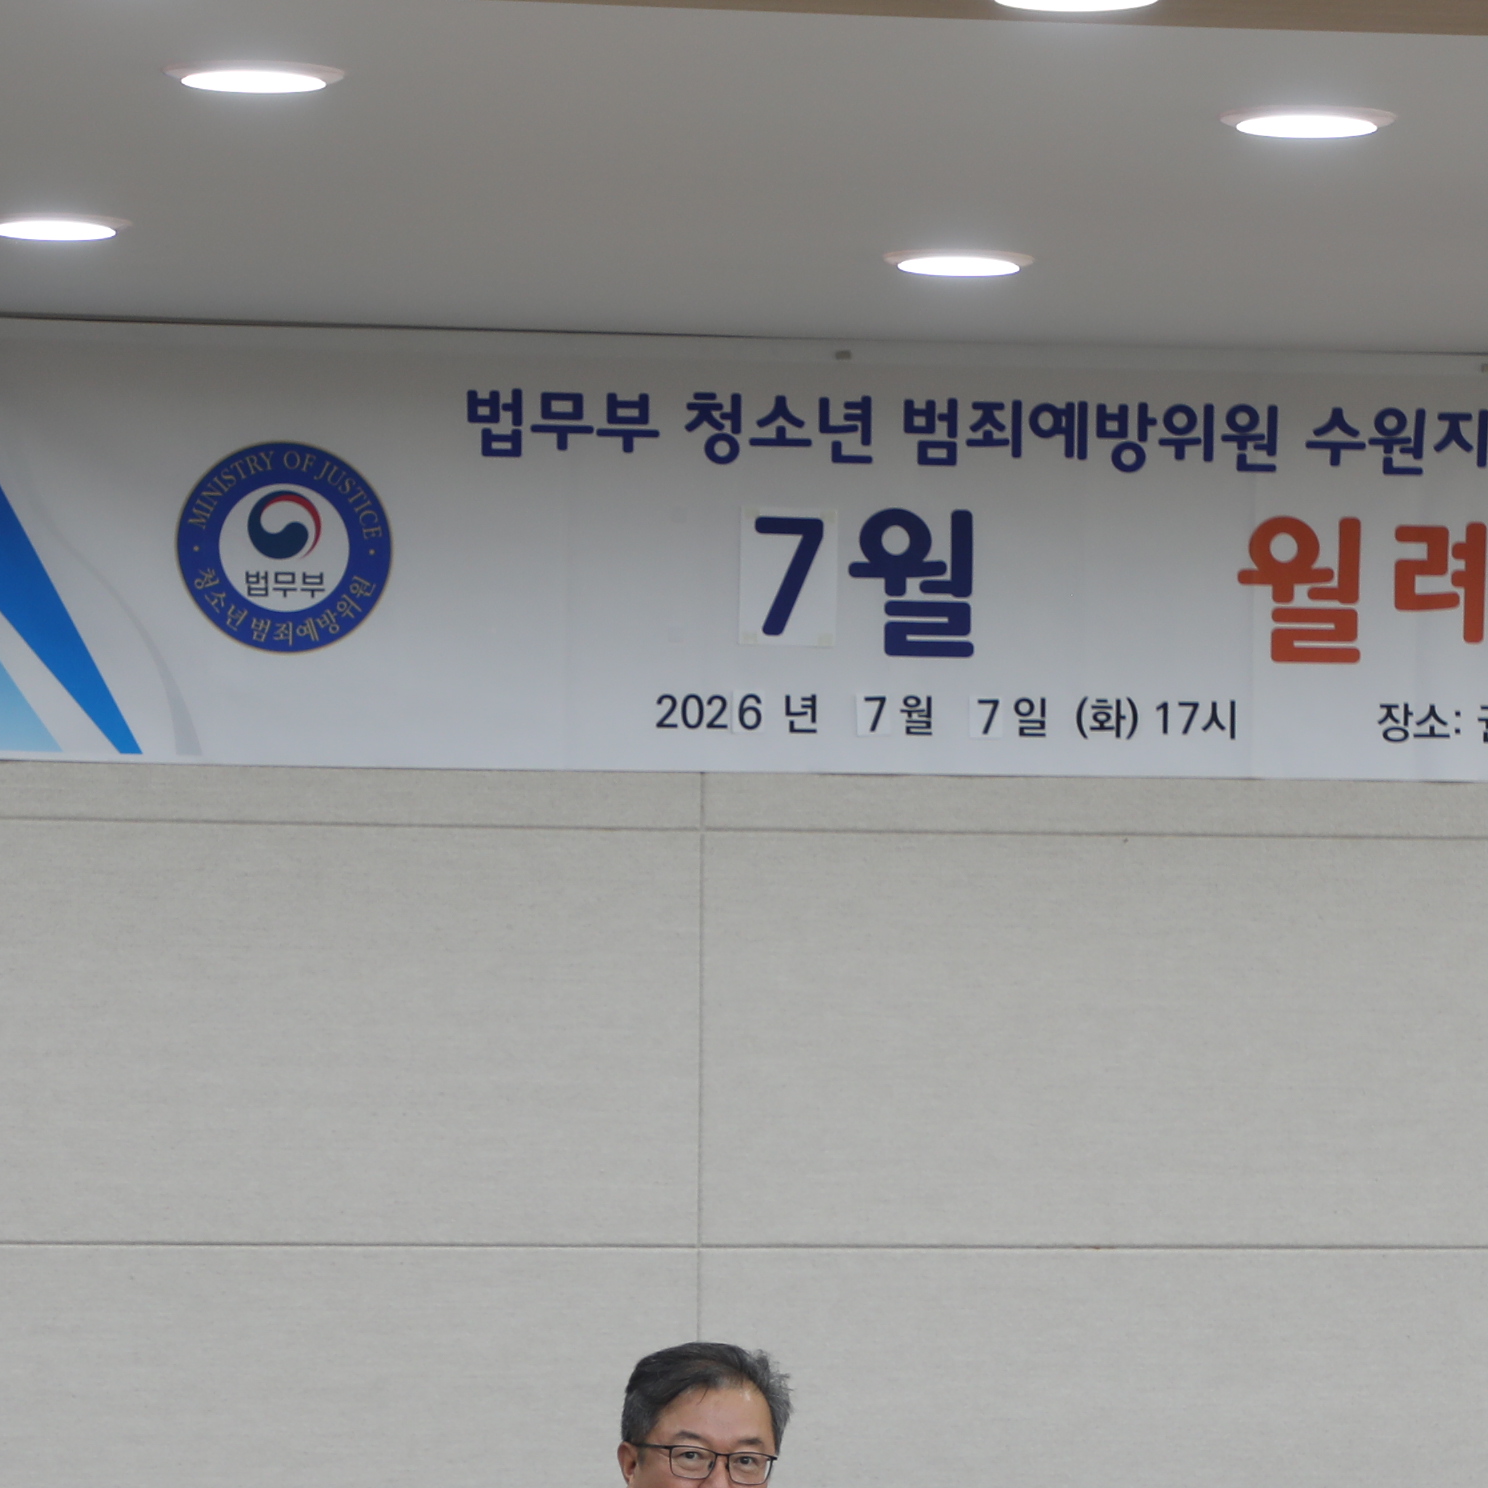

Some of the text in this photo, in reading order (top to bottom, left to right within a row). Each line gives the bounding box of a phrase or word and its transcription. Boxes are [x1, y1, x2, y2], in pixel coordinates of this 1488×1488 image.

[466, 387, 660, 458] 법무부
[684, 391, 873, 465] 청소년
[903, 397, 1279, 474] 범죄예방위원
[188, 450, 383, 540] MINISTRY OF JUSTICE
[193, 566, 377, 646] 청소년 범죄예방위원
[244, 570, 326, 599] 법무부
[754, 507, 975, 659] 7월
[655, 693, 1237, 740] 2026 년 7월 7일 (화) 17시
[1377, 702, 1462, 743] 장소:
